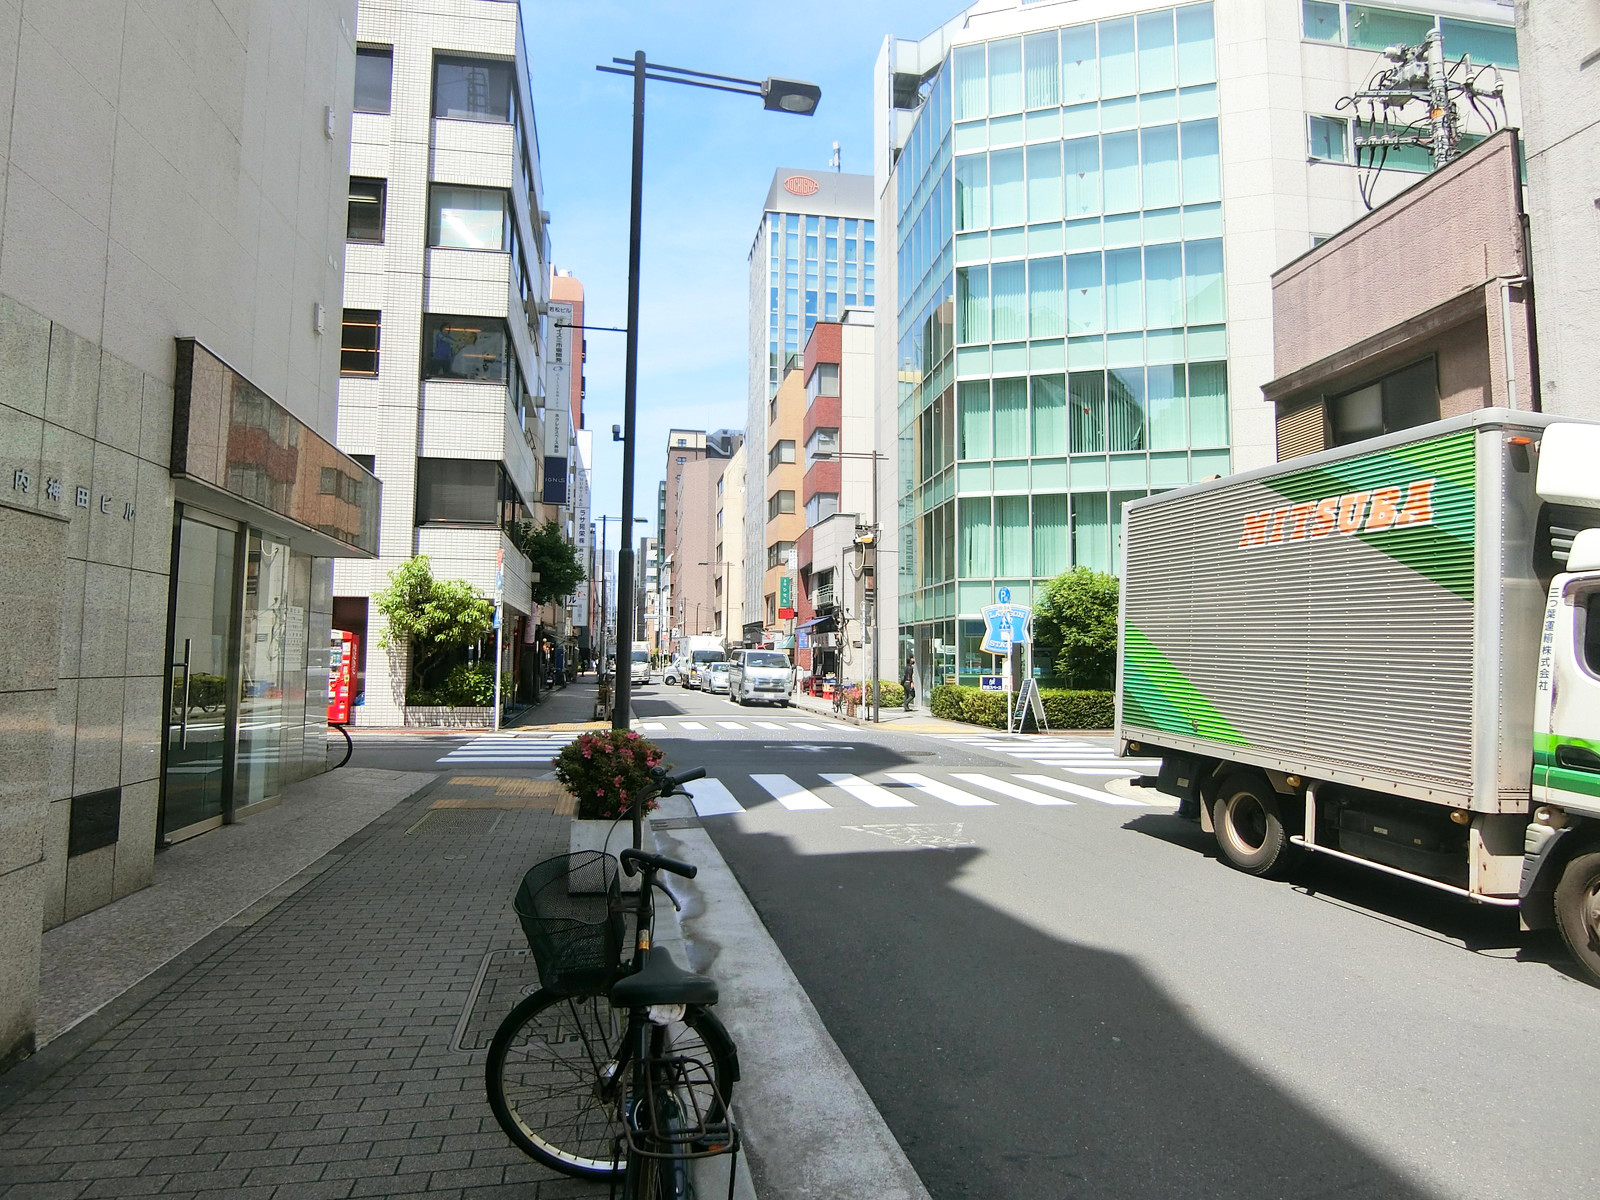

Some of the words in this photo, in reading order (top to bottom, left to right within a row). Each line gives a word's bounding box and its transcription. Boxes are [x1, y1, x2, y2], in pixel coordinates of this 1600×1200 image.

[13, 469, 136, 521] 内神田ビル
[1238, 478, 1436, 550] MITSUBA
[1538, 587, 1560, 691] 三つ葉運輸株式会社
